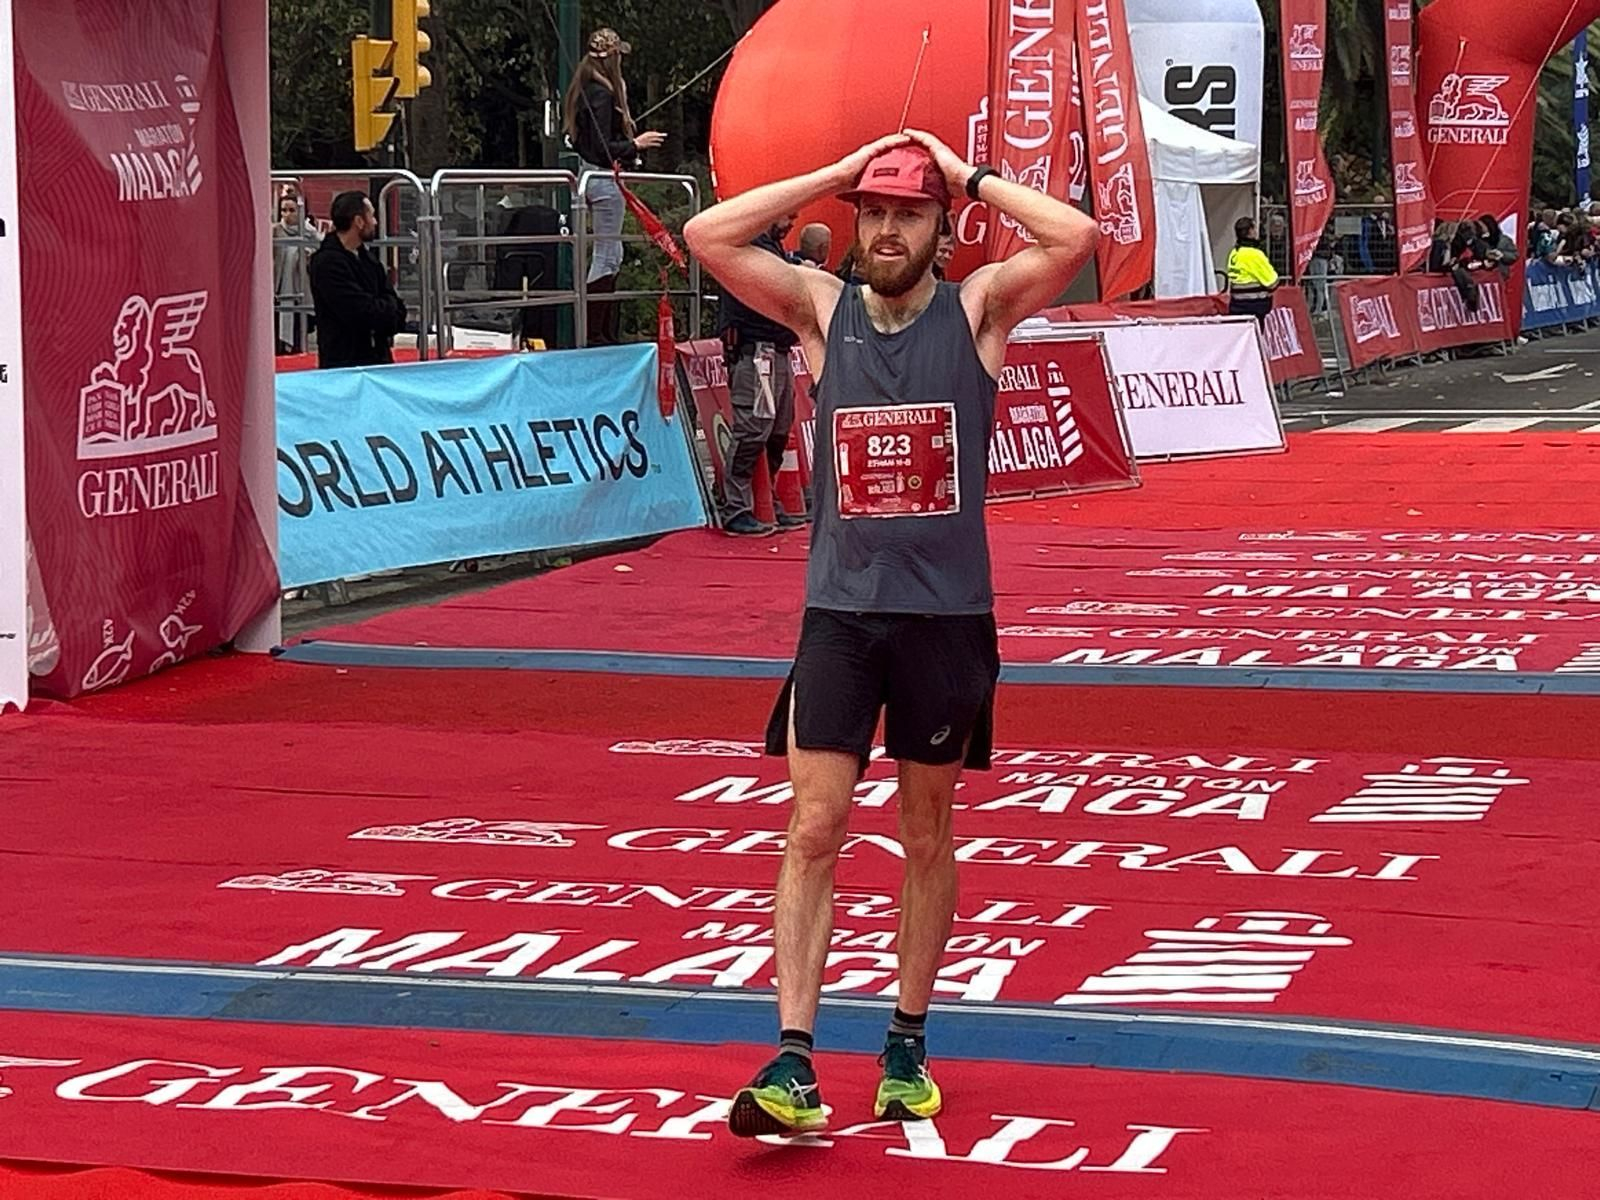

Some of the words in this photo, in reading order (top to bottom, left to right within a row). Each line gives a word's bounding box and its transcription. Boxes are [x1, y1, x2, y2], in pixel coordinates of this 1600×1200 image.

[79, 80, 171, 112] GENERALI
[1427, 127, 1508, 145] GENERALI
[1114, 369, 1248, 410] ENERALI
[863, 409, 937, 427] GENERALI
[421, 409, 650, 499] ATHLETICS
[867, 434, 911, 457] 823
[77, 450, 219, 518] GENERALI
[1109, 627, 1550, 645] GENERALI
[431, 879, 1112, 928] GENERLI
[682, 921, 1046, 959] MARAÓN
